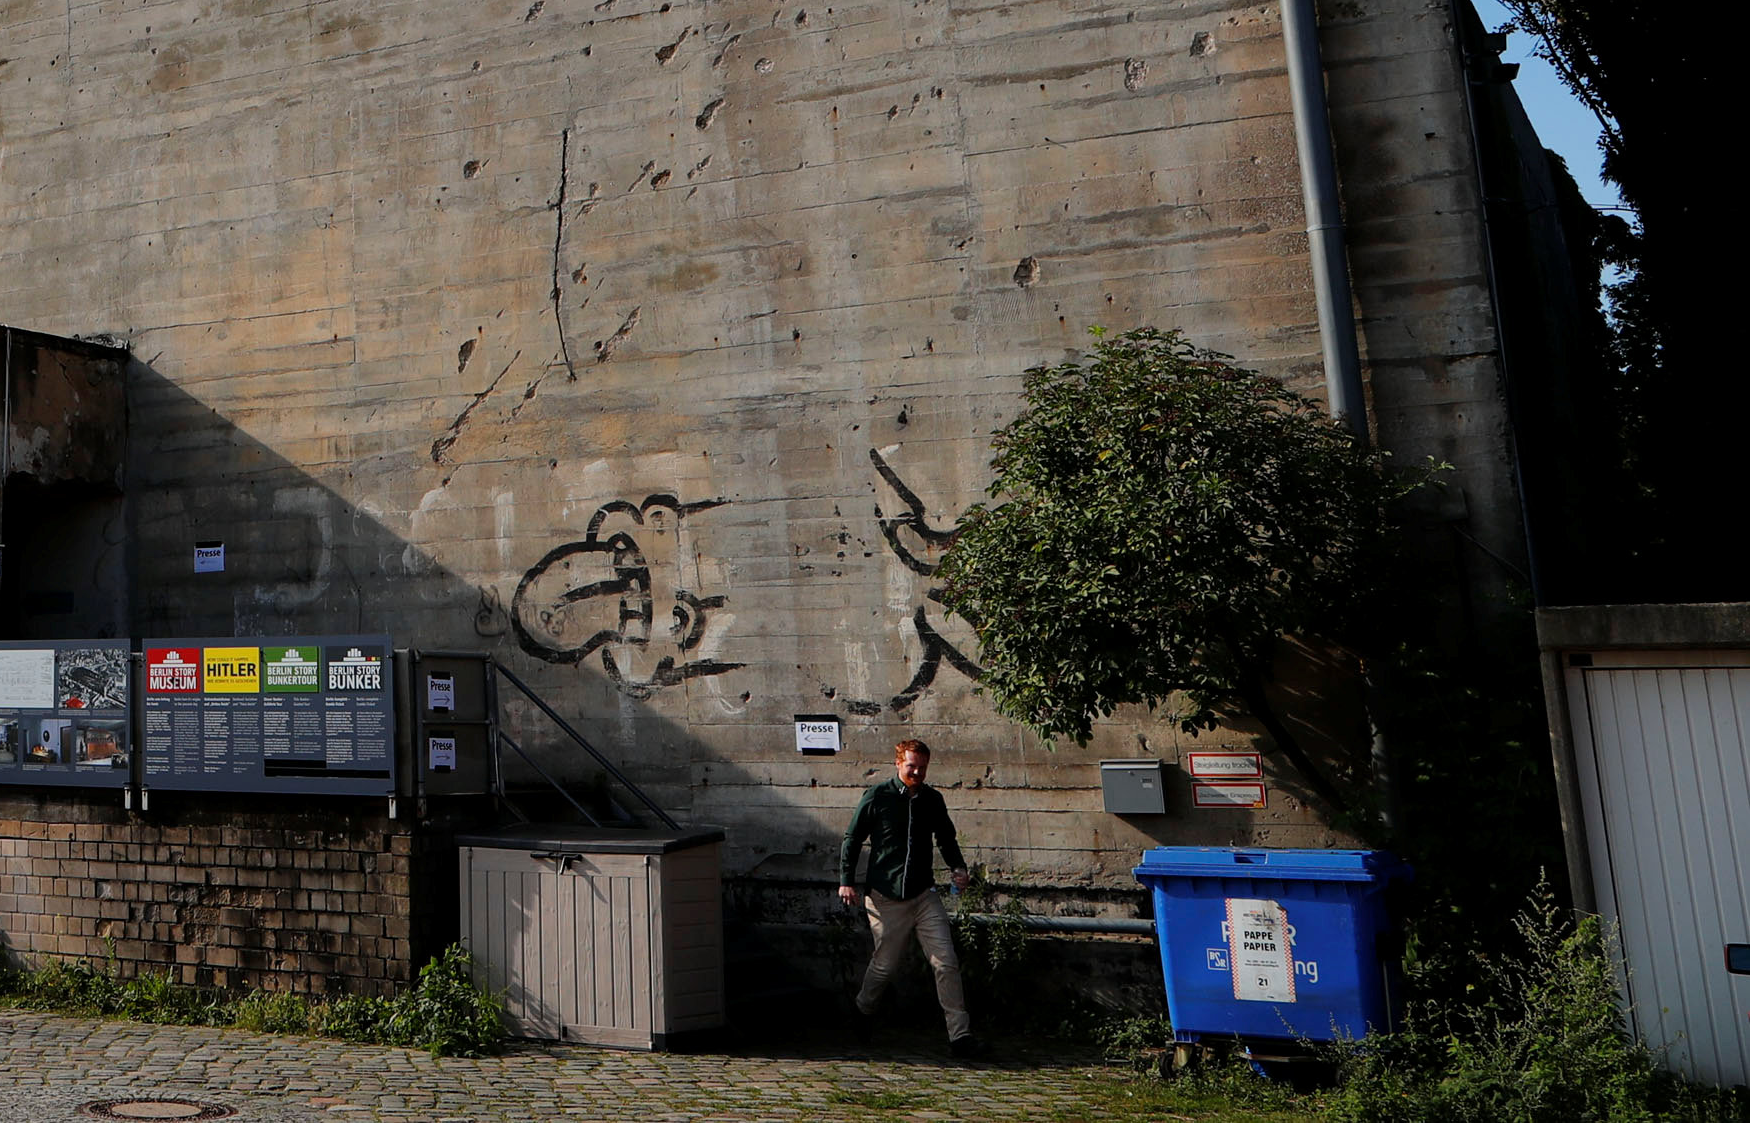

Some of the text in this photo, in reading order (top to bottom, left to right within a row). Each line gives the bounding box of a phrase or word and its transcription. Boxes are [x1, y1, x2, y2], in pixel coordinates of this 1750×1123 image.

[197, 548, 222, 559] Presse
[149, 667, 196, 677] BERLIN STORY
[206, 663, 257, 677] HITLER
[267, 666, 318, 675] BERLIN STORY
[328, 666, 381, 675] BERLIN STORY
[149, 676, 197, 690] MUSEUM
[267, 675, 318, 686] BUNKERTOUR
[328, 674, 381, 690] BUNKER
[431, 681, 451, 691] Presse
[800, 723, 834, 733] Presse
[432, 740, 453, 750] Presse
[1244, 930, 1274, 941] PAPPE
[1243, 942, 1277, 952] PAPIER
[1209, 951, 1227, 968] BSR
[1257, 977, 1269, 987] 21
